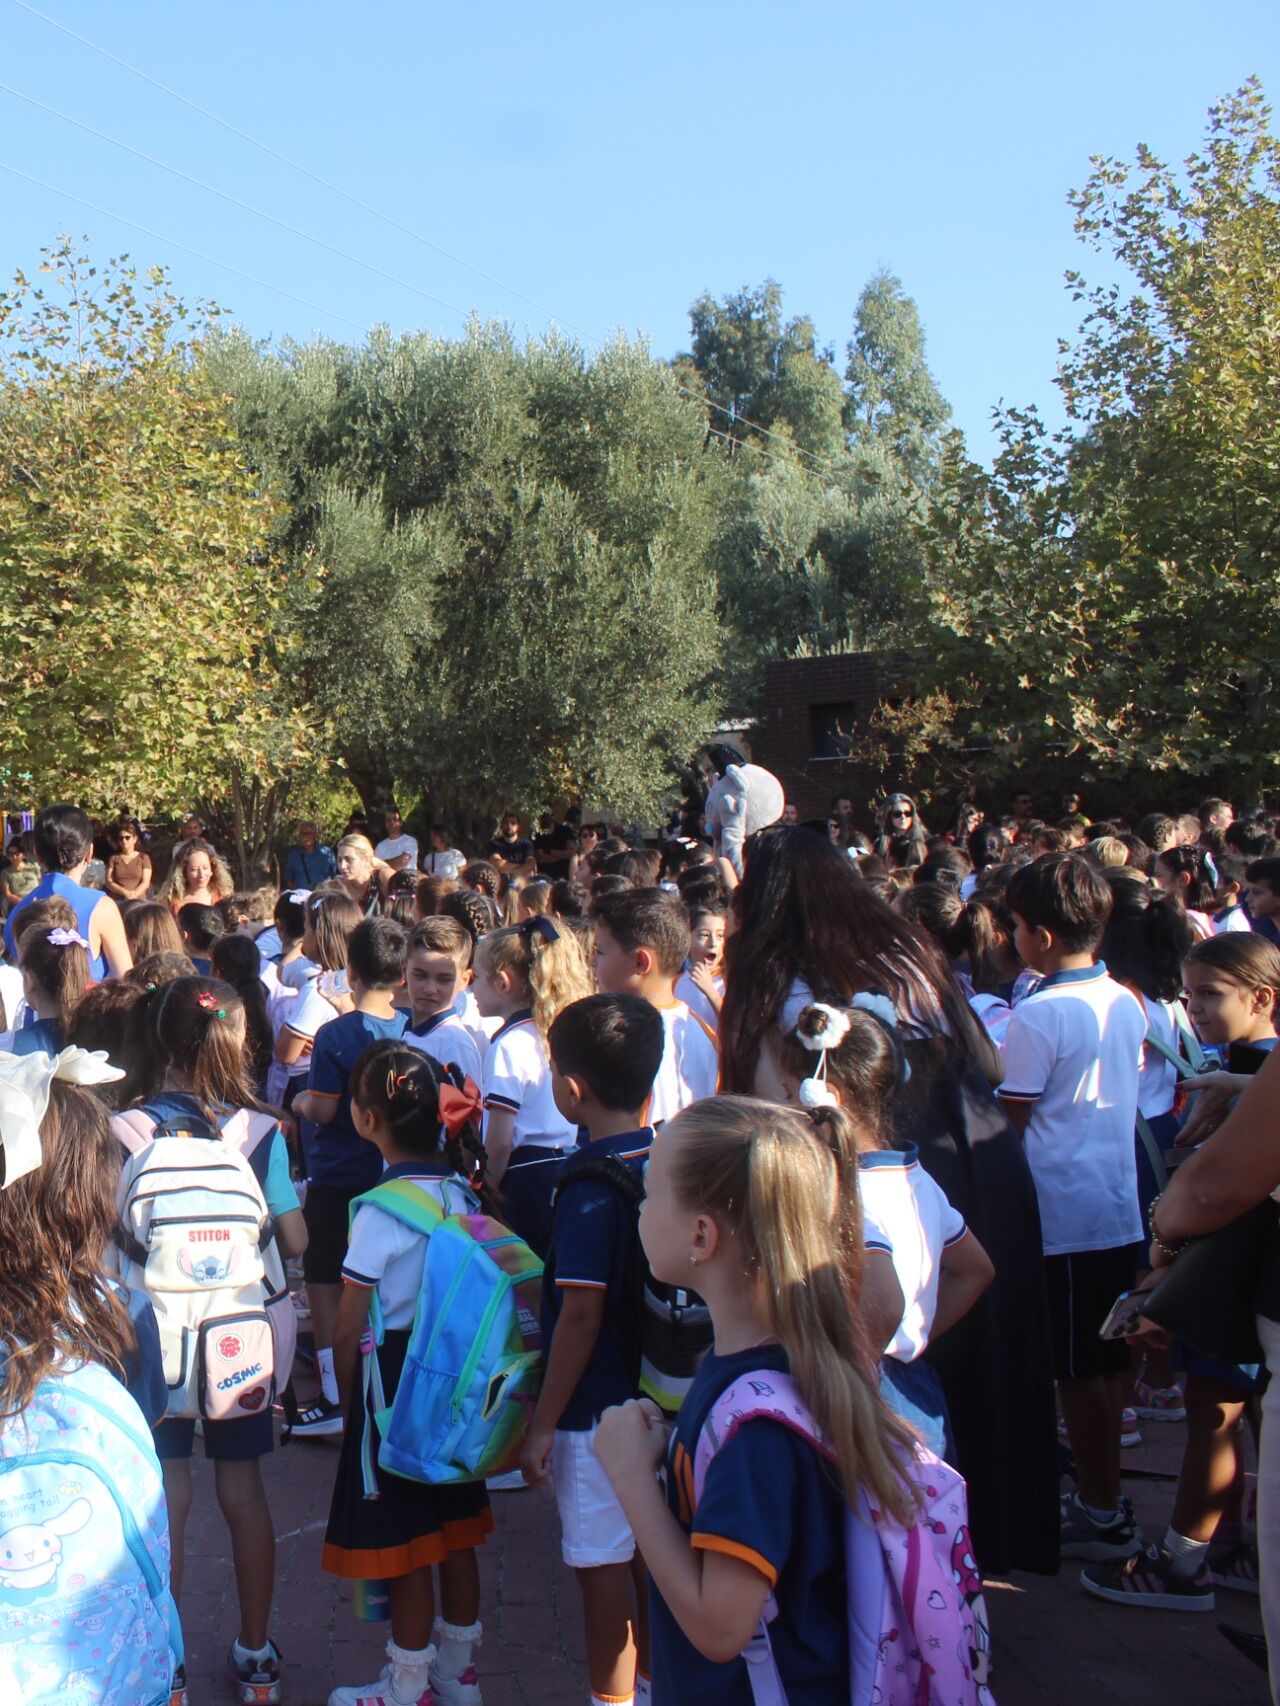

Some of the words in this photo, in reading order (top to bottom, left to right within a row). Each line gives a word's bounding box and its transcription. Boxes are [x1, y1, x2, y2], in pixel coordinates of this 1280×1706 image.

[188, 1229, 231, 1242] STITCH
[216, 1363, 263, 1391] COSMIC
[12, 1488, 43, 1503] heart
